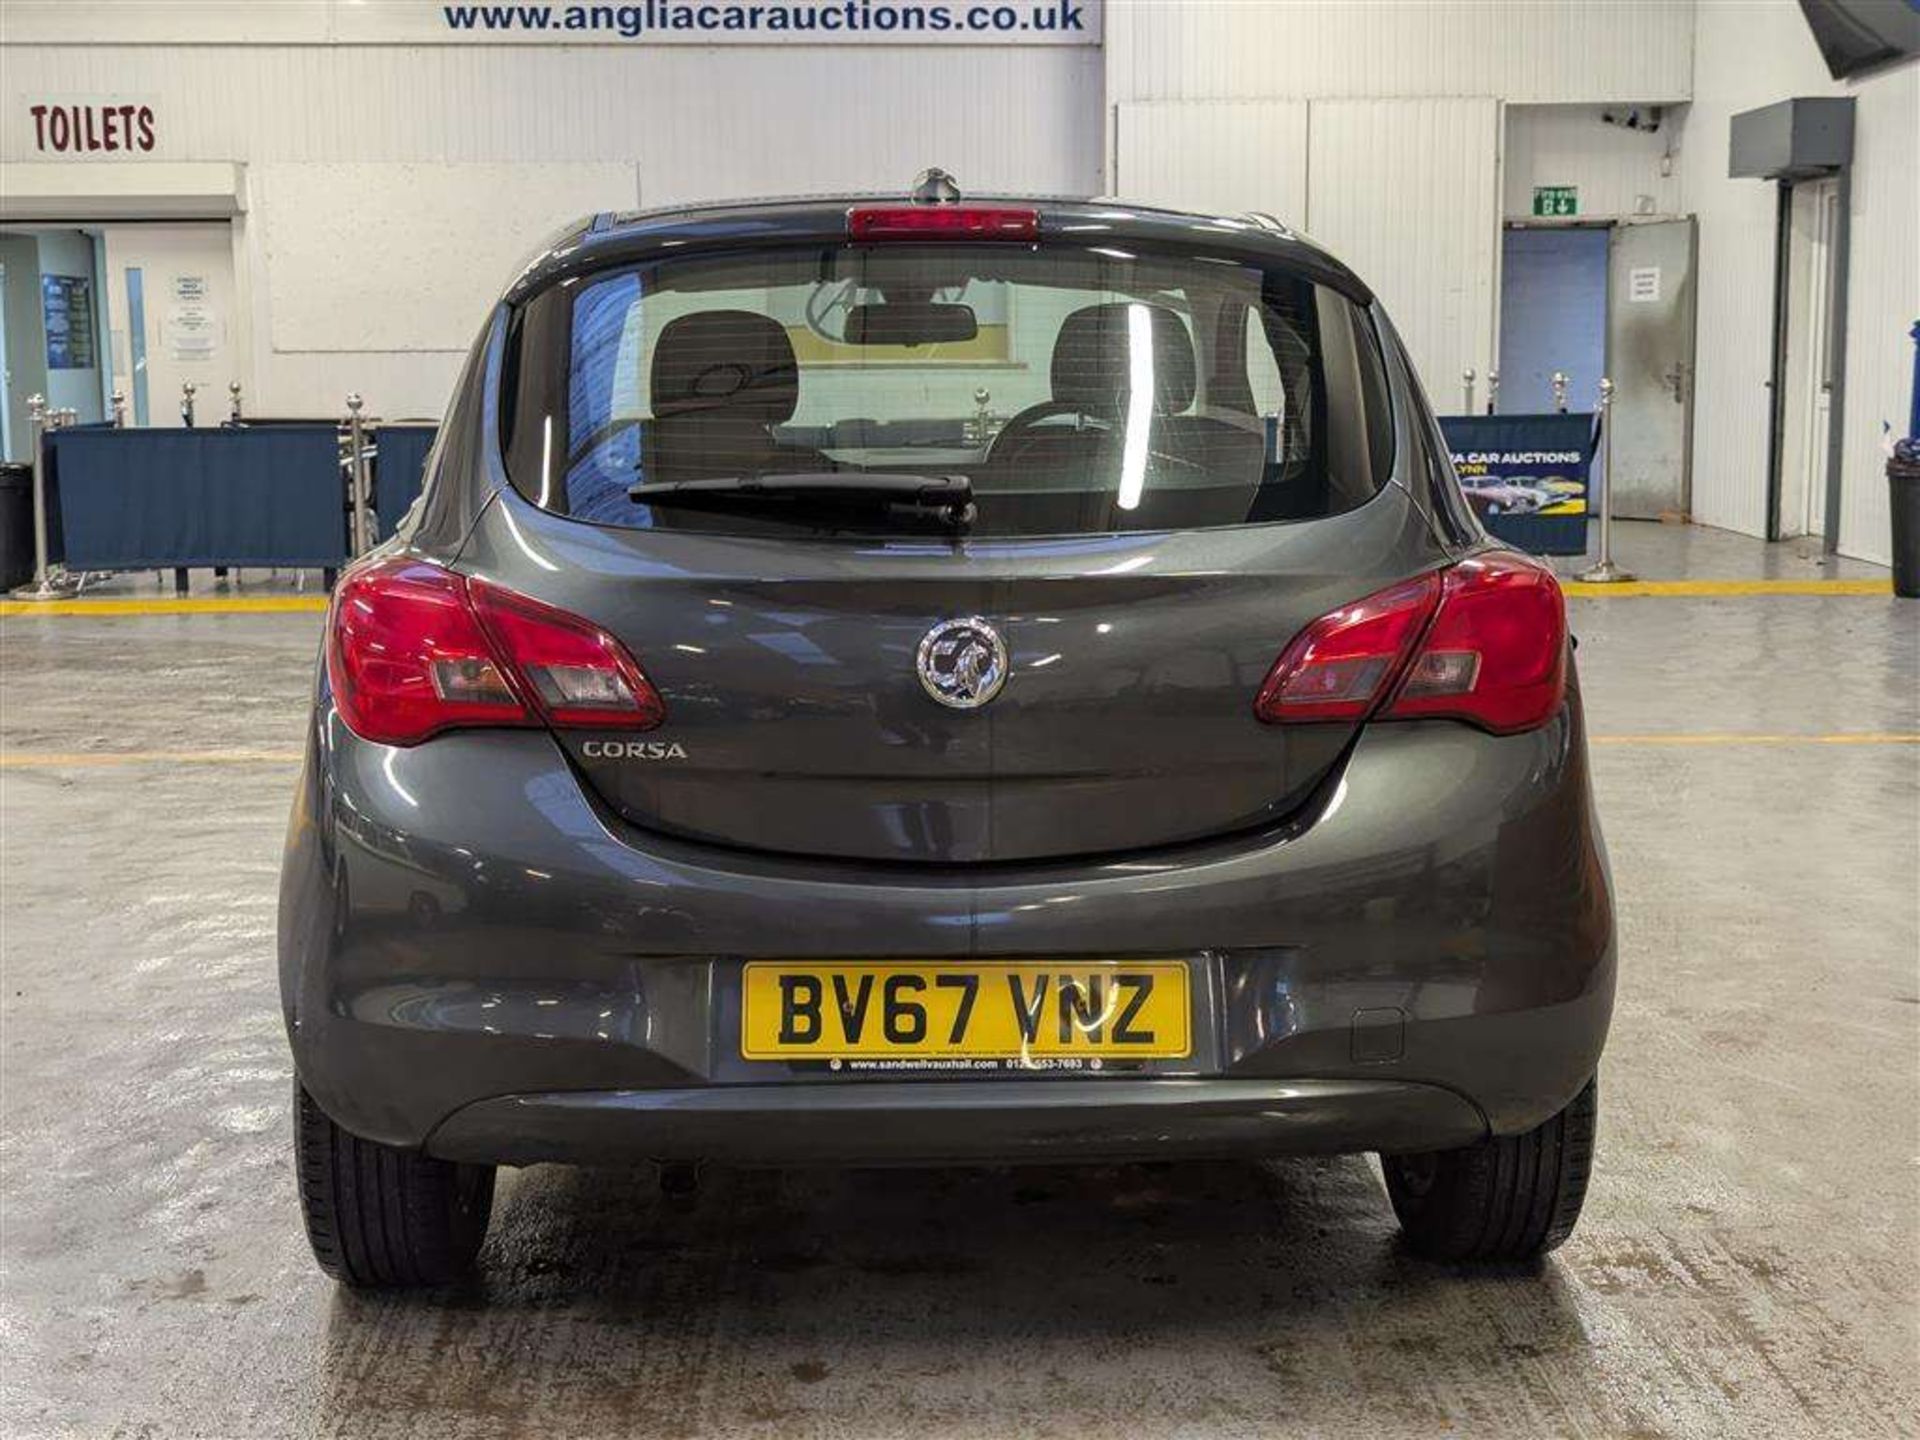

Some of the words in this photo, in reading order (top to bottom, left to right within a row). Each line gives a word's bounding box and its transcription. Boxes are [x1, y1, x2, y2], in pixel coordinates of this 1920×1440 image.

[443, 0, 1083, 38] www.angliacarauctions.co.uk
[30, 104, 156, 152] TOILETS
[1467, 452, 1500, 464] CAR
[1502, 451, 1580, 464] AUCTIONS
[582, 741, 688, 759] CORSA
[778, 974, 979, 1044] BV67
[1007, 974, 1155, 1043] VNZ
[850, 1059, 998, 1069] www.sandwellvauxhall.com
